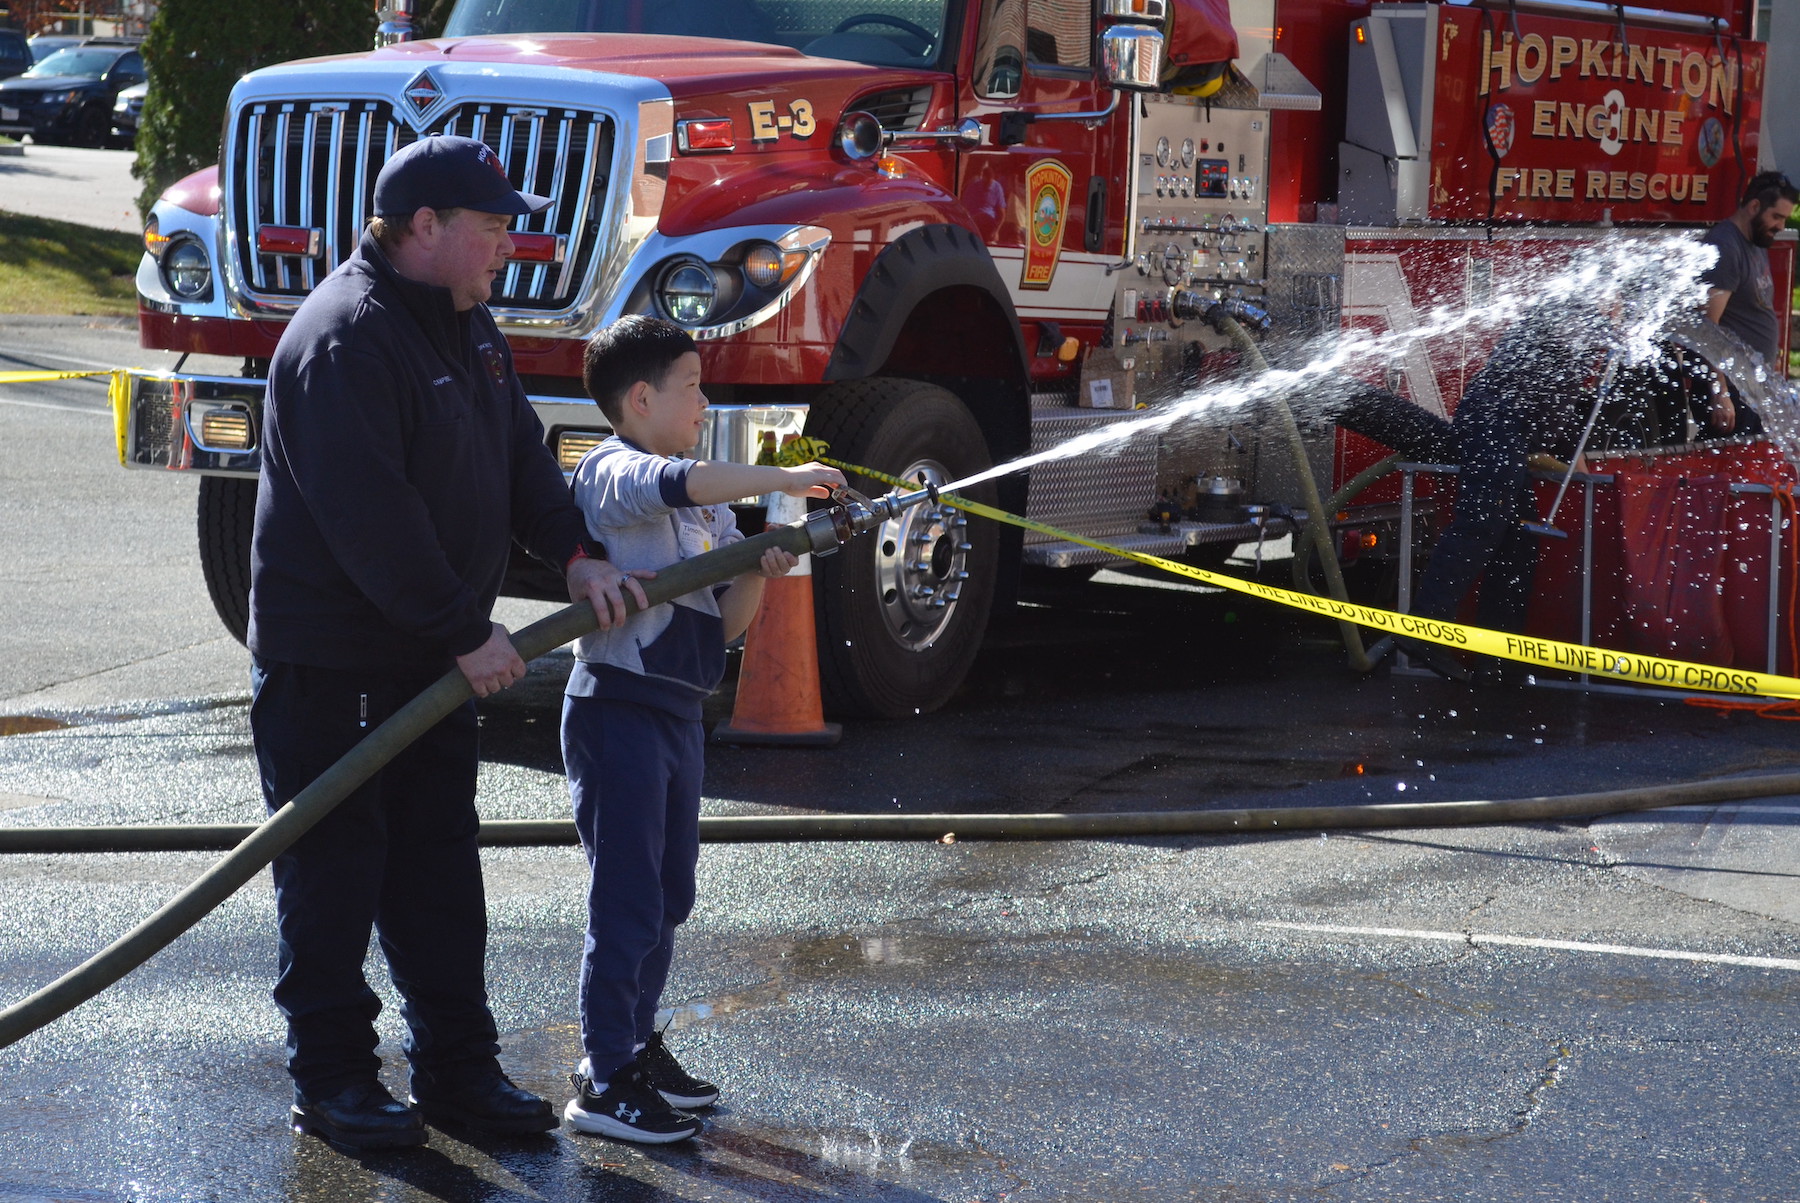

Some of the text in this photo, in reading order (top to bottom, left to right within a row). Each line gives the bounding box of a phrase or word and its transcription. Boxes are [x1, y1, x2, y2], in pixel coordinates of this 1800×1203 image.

[1479, 29, 1737, 116] HOPKINTON
[748, 98, 816, 141] E-3
[1532, 100, 1685, 145] ENGINE
[1600, 89, 1625, 155] 3
[1031, 169, 1067, 191] HOPKINTON
[1495, 167, 1709, 202] FIRE RESCUE
[1029, 265, 1050, 278] FIRE
[1287, 592, 1327, 611] LINE
[1328, 601, 1356, 618] DO
[1359, 608, 1395, 628] NOT
[1401, 617, 1467, 644] CROSS
[1506, 637, 1758, 694] FIRE LINE DO NOT CROSS
